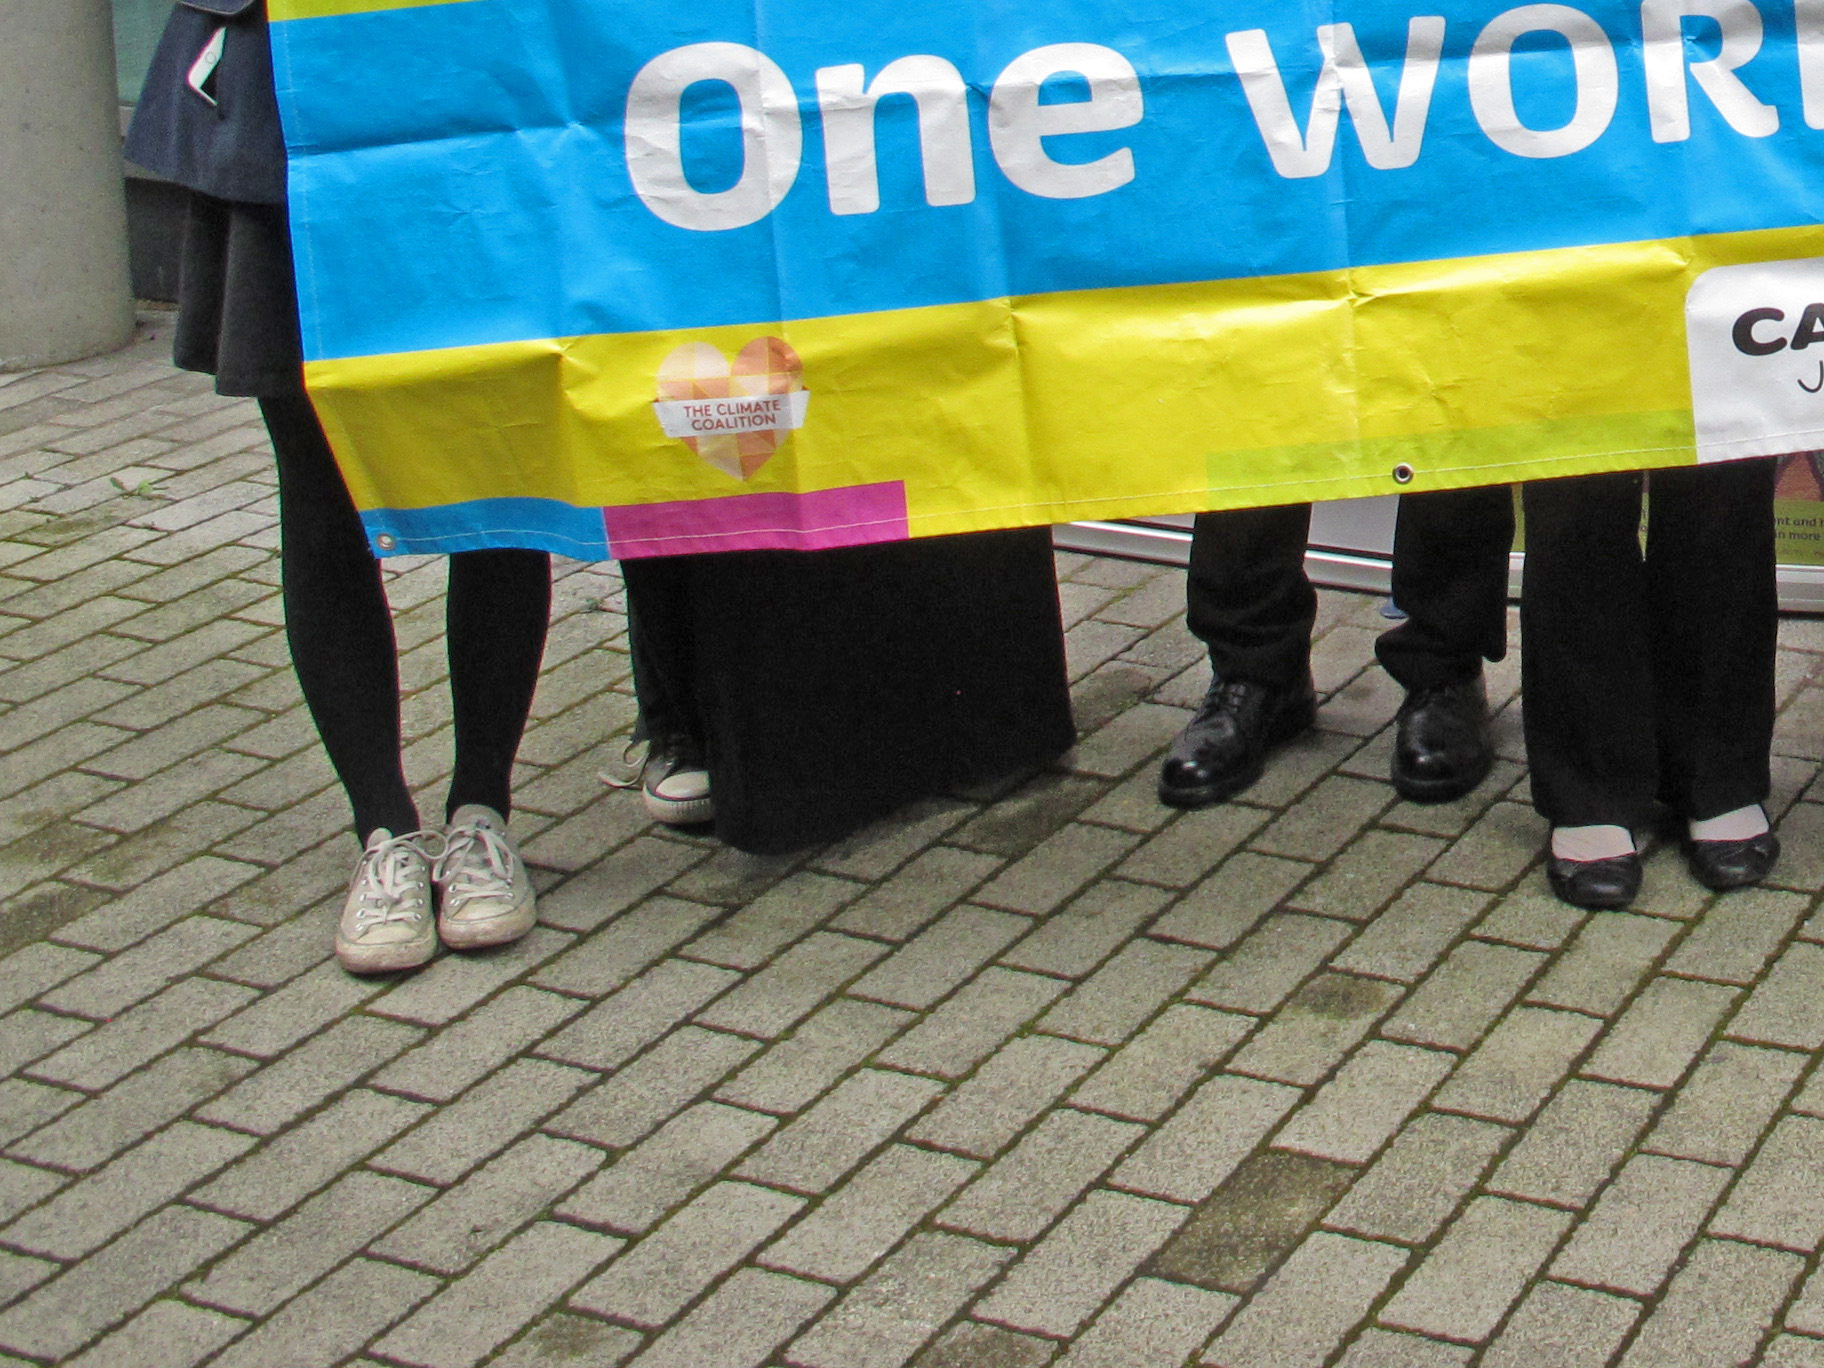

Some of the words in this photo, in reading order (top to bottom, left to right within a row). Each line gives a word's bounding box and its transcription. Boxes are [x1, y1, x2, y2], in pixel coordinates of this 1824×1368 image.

[624, 41, 1144, 232] One
[683, 404, 712, 417] THE
[716, 399, 781, 416] CLIMATE
[691, 414, 777, 431] COALITION
[1789, 532, 1820, 541] more
